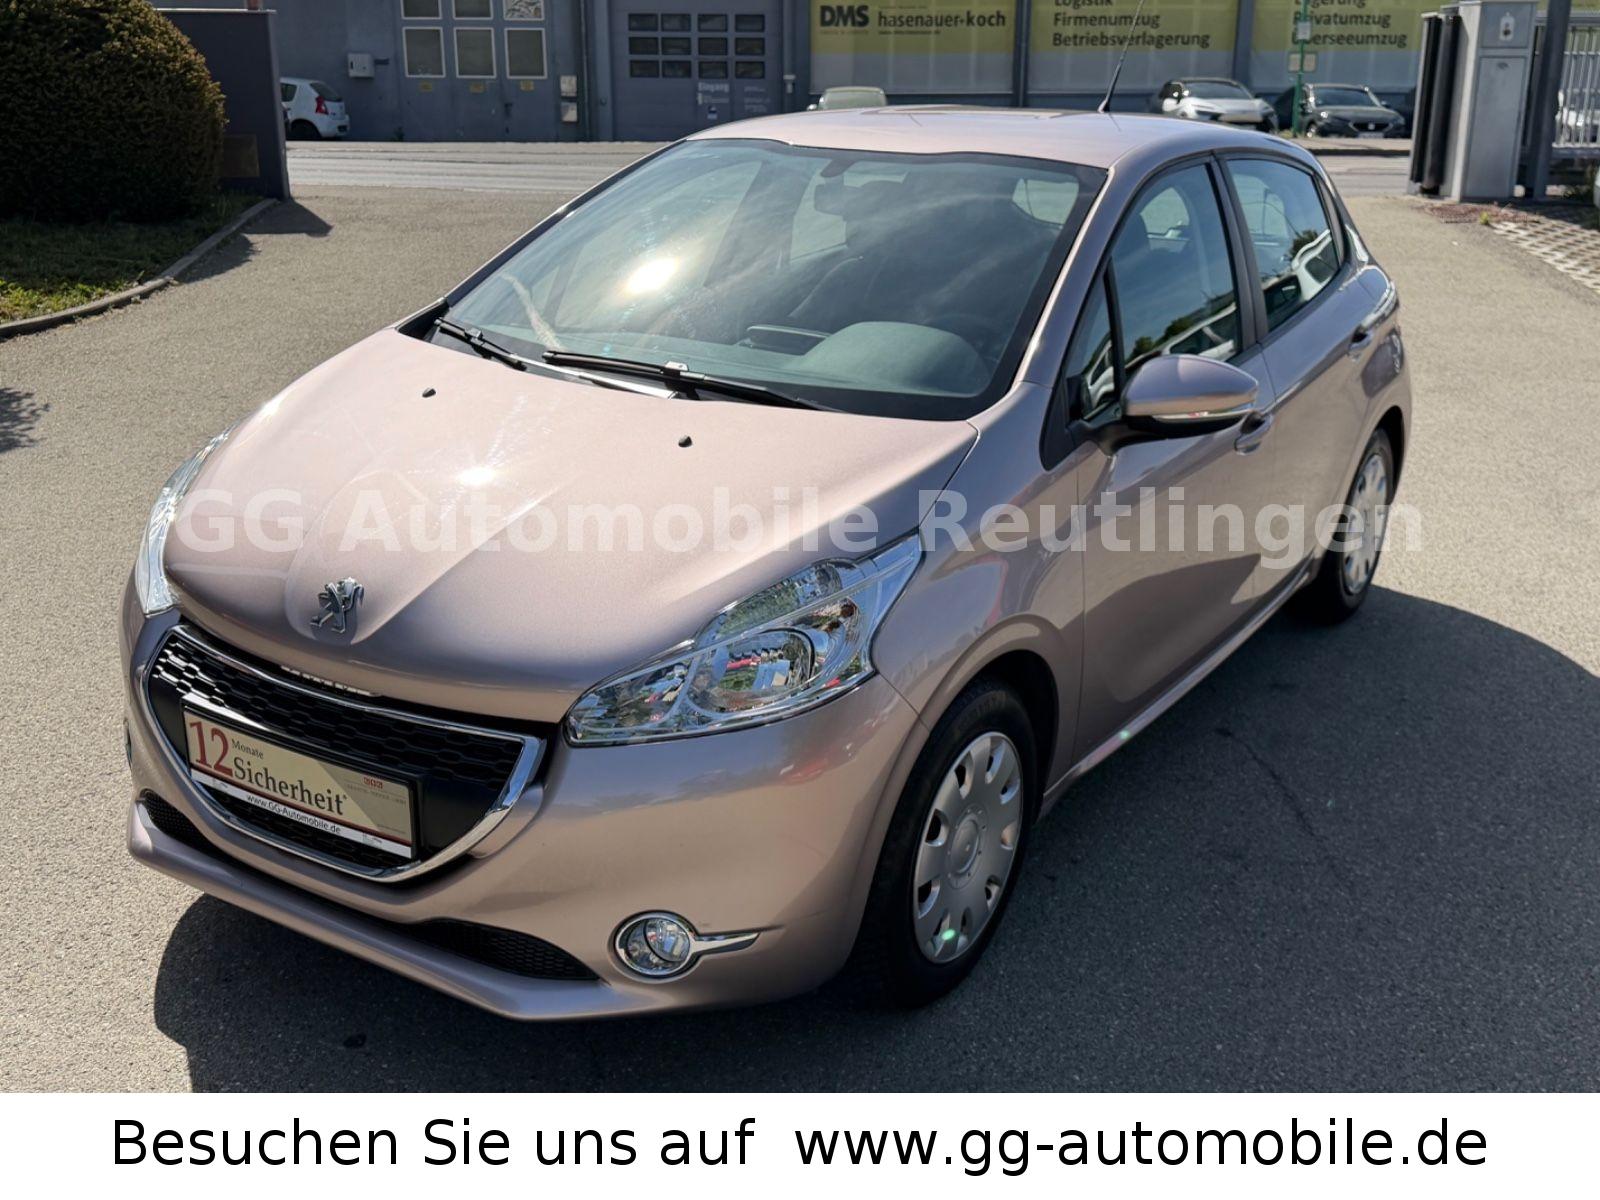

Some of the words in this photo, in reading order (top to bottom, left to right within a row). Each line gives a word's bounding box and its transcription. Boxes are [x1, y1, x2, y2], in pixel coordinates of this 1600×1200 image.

[819, 5, 870, 28] DMS
[1053, 12, 1161, 29] Firmenumzug
[1293, 11, 1392, 29] Pivatumzug
[1052, 32, 1211, 49] Betriebsverlagerung
[190, 721, 234, 778] 12
[231, 738, 265, 760] Monate
[246, 794, 342, 835] www.GG-Automobile.de
